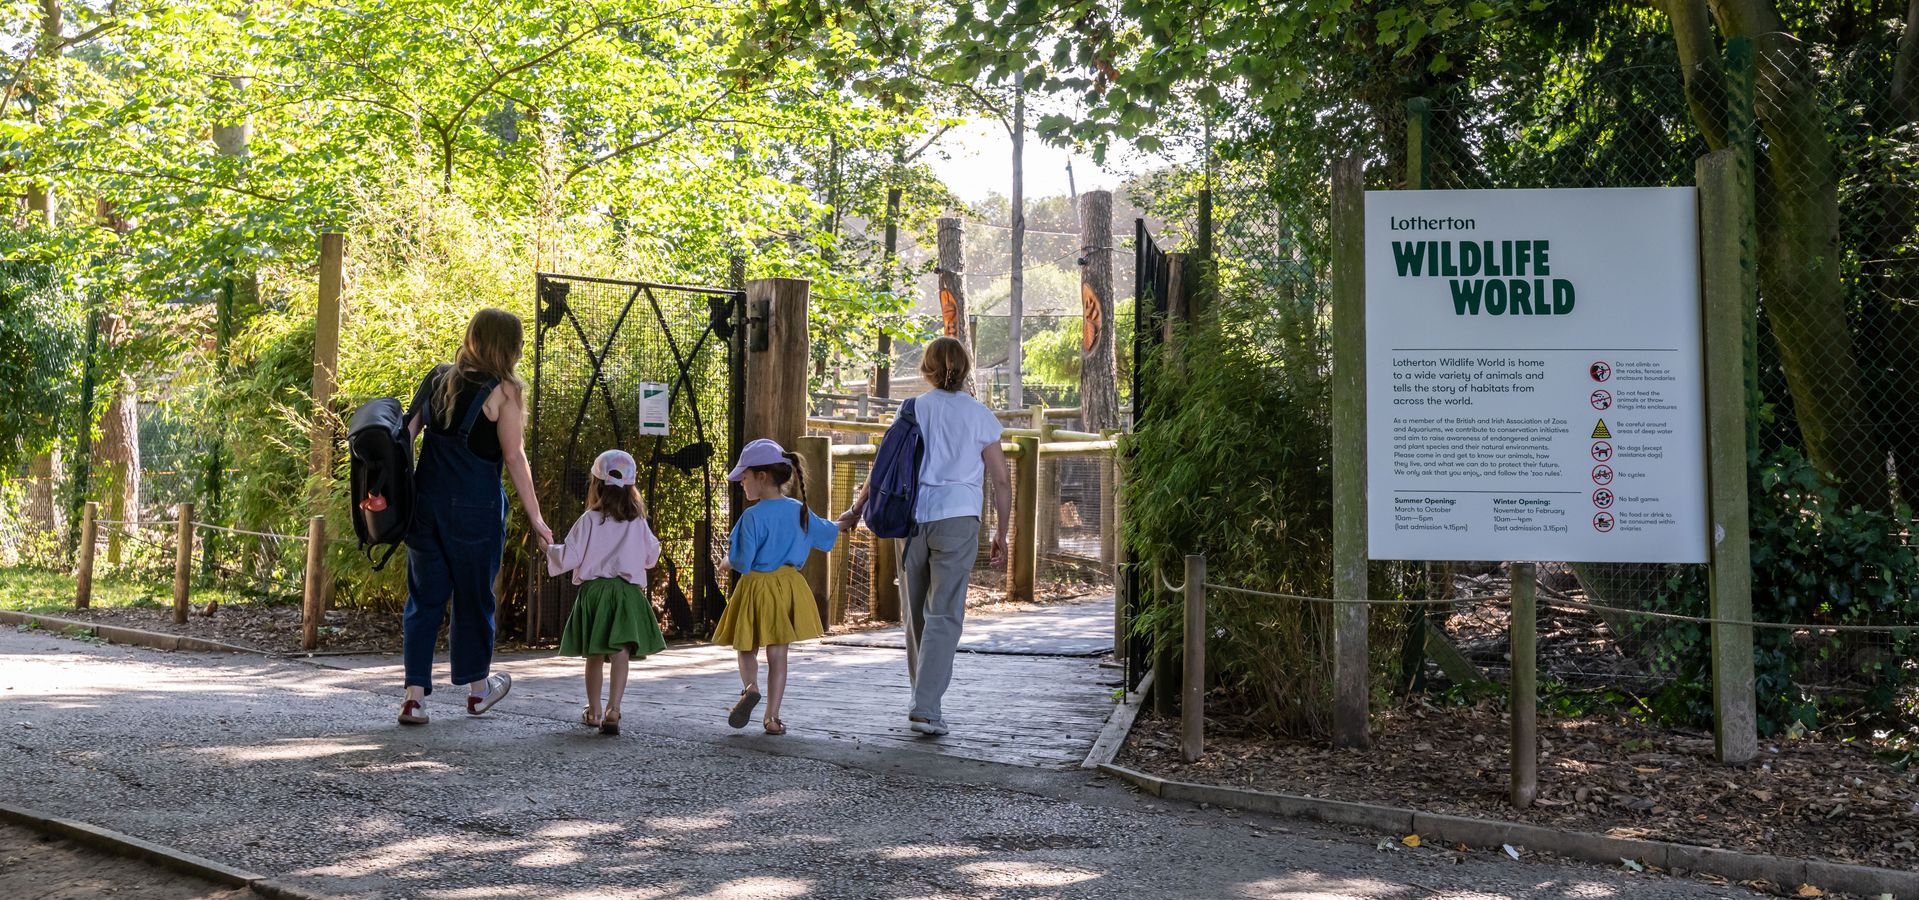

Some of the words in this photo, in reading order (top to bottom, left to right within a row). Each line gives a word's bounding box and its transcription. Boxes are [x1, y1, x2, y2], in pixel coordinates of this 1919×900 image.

[1391, 217, 1475, 230] Lotherton
[1392, 240, 1550, 276] WILDLIFE
[1449, 279, 1575, 315] WORLD
[1393, 358, 1436, 367] Lotherton
[1440, 358, 1474, 367] Wildlife
[1477, 358, 1505, 367] World
[1508, 358, 1515, 367] is
[1518, 358, 1544, 367] home
[1414, 371, 1436, 380] wide
[1439, 371, 1471, 382] variety
[1474, 371, 1484, 380] of
[1486, 371, 1522, 380] animals
[1525, 371, 1544, 380] and
[1394, 384, 1411, 392] tells
[1414, 384, 1429, 392] the
[1432, 385, 1455, 395] story
[1458, 384, 1468, 392] of
[1471, 384, 1509, 392] habitats
[1512, 384, 1534, 392] from
[1427, 396, 1442, 405] the
[1444, 397, 1473, 405] world.
[1490, 435, 1529, 443] endangered
[1407, 443, 1425, 451] plant
[1426, 443, 1450, 451] species
[1394, 460, 1408, 468] they
[1424, 498, 1456, 506] Opening:
[1536, 507, 1565, 516] February
[1395, 523, 1409, 532] (last
[1444, 524, 1468, 532] 4.15pm)
[1494, 524, 1508, 533] (last
[1543, 524, 1568, 533] 3.15pm)
